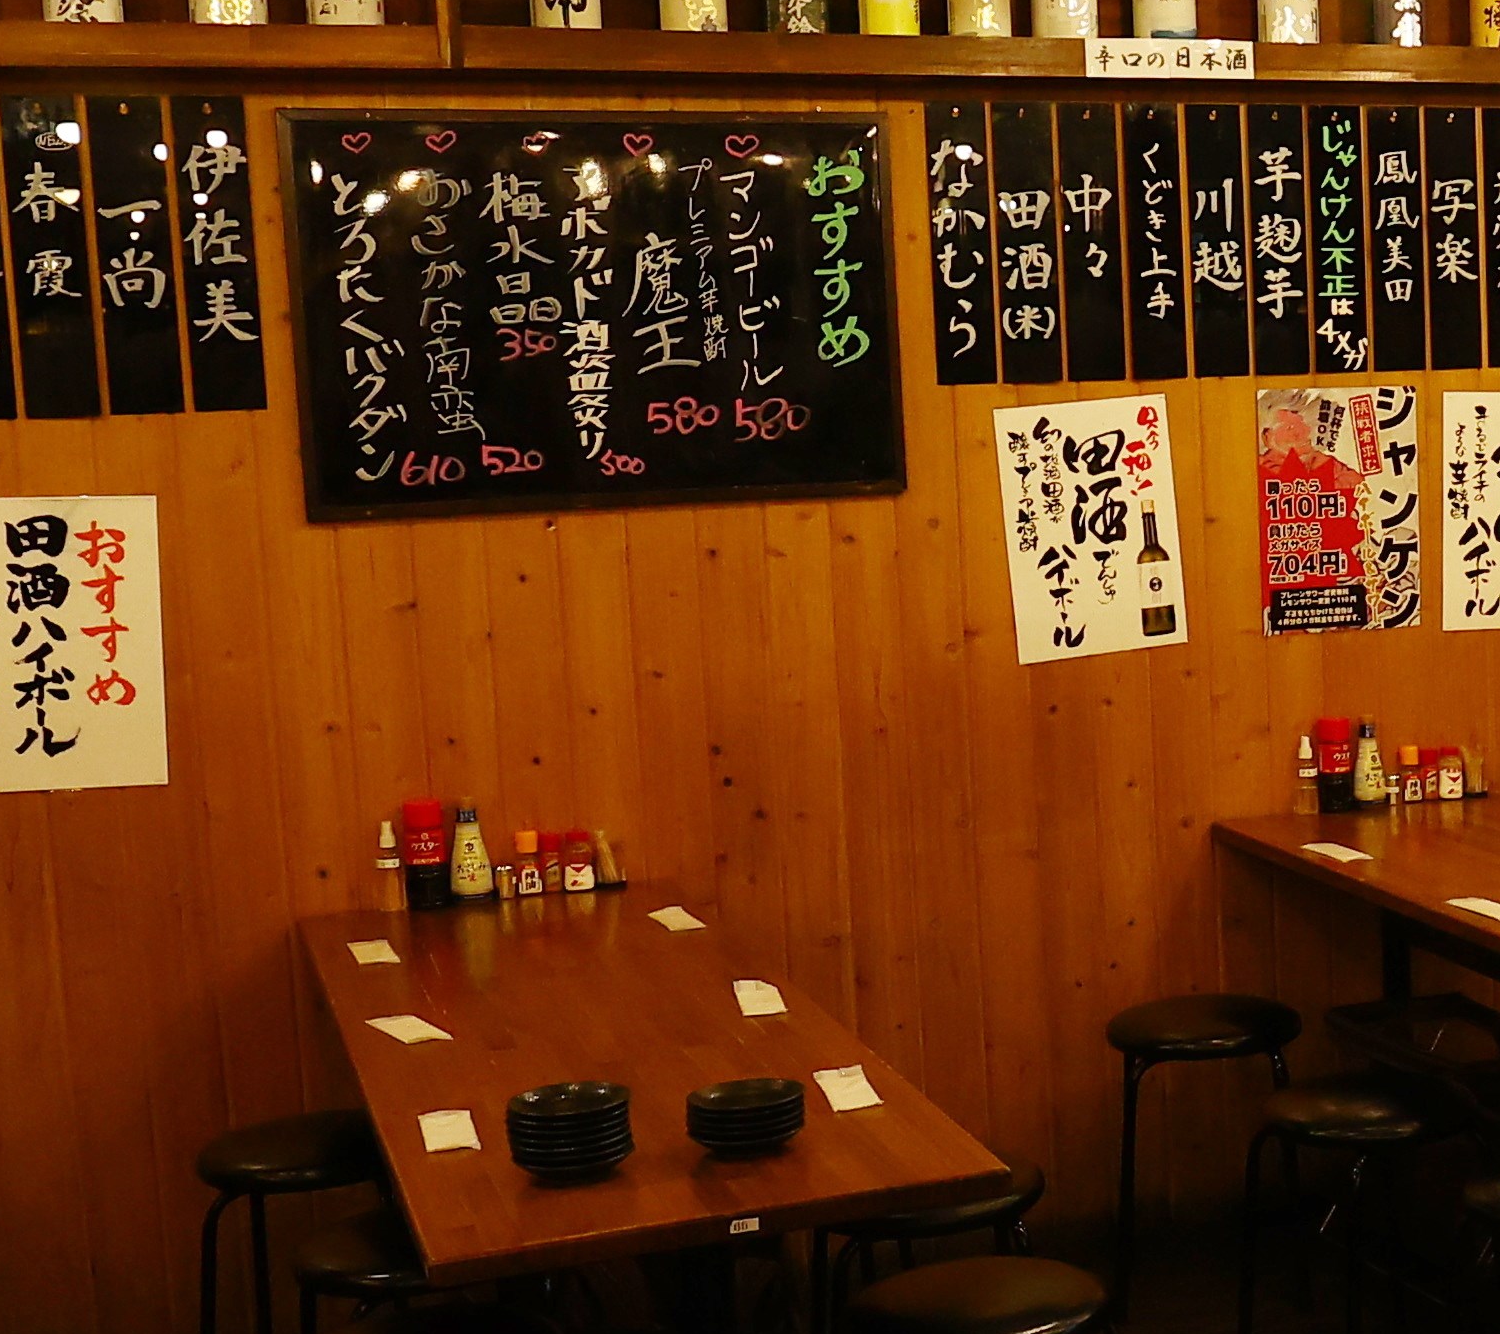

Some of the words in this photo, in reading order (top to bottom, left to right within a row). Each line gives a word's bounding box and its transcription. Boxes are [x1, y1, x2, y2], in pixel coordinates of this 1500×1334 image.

[1094, 46, 1249, 72] 辛口の日本酒
[13, 162, 83, 297] 春霞
[98, 200, 166, 309] 一尚
[182, 144, 259, 342] 伊佐美
[479, 171, 563, 324] 梅水晶
[678, 157, 729, 361] プレミアム芋焼酎
[719, 169, 783, 391] マンゴービール
[809, 149, 871, 367] おすすめ
[930, 139, 986, 358] なかむら
[998, 190, 1055, 340] 田酒(米)
[1064, 174, 1112, 277] 中々
[1140, 142, 1177, 319] くどき上手
[1194, 178, 1244, 291] 川越
[1254, 147, 1303, 319] 芋麹芋
[1374, 150, 1420, 303] 鳳凰美田
[1431, 179, 1478, 284] 写楽
[331, 173, 406, 480] とろたくバクダン
[412, 168, 486, 442] おさかな南蛮
[500, 327, 556, 361] 350
[622, 233, 702, 374] 魔王
[401, 450, 465, 486] 610
[480, 444, 544, 476] 520
[647, 396, 720, 435] 580
[734, 398, 811, 441] 580
[1448, 422, 1470, 521] ような芋焼酎
[1062, 429, 1129, 545] 田酒
[1265, 492, 1340, 519] 110円
[1377, 386, 1421, 629] ジャンケン
[74, 520, 137, 706] おすすめ
[1268, 550, 1341, 576] 704円
[3, 515, 82, 757] 田酒ハイボール
